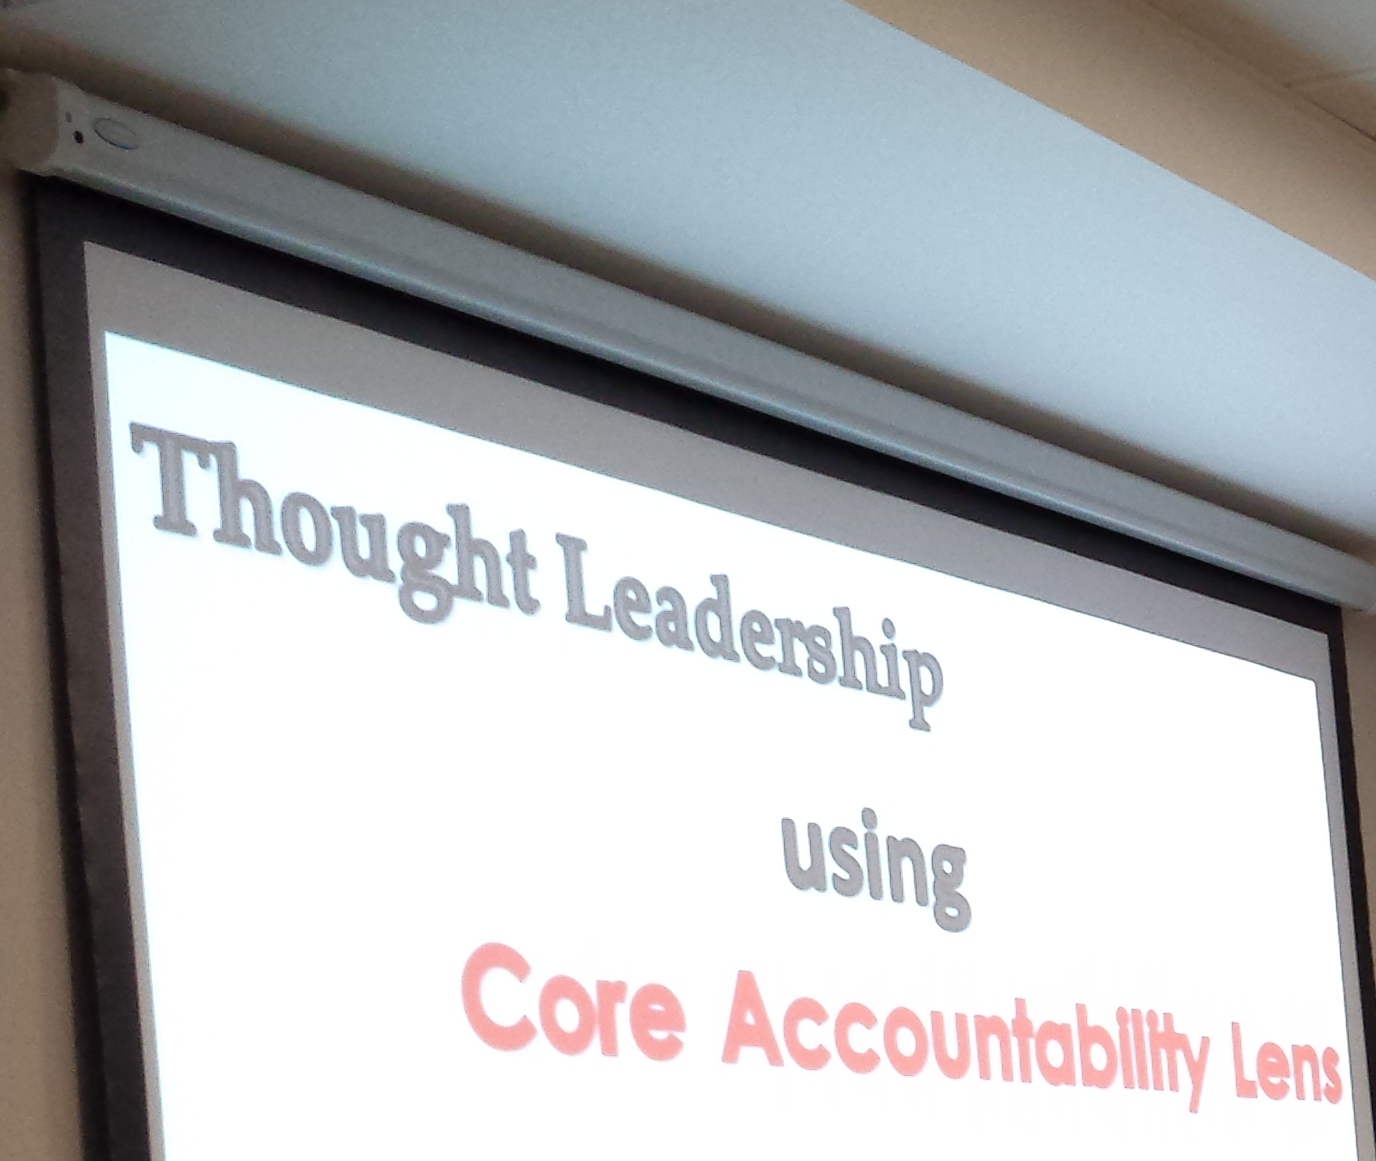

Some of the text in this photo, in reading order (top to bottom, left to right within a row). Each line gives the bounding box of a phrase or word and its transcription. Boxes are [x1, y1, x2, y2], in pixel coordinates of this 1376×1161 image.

[127, 420, 944, 733] Thought Leadership
[781, 807, 972, 933] using
[461, 942, 1344, 1114] Core Accountability Lens
